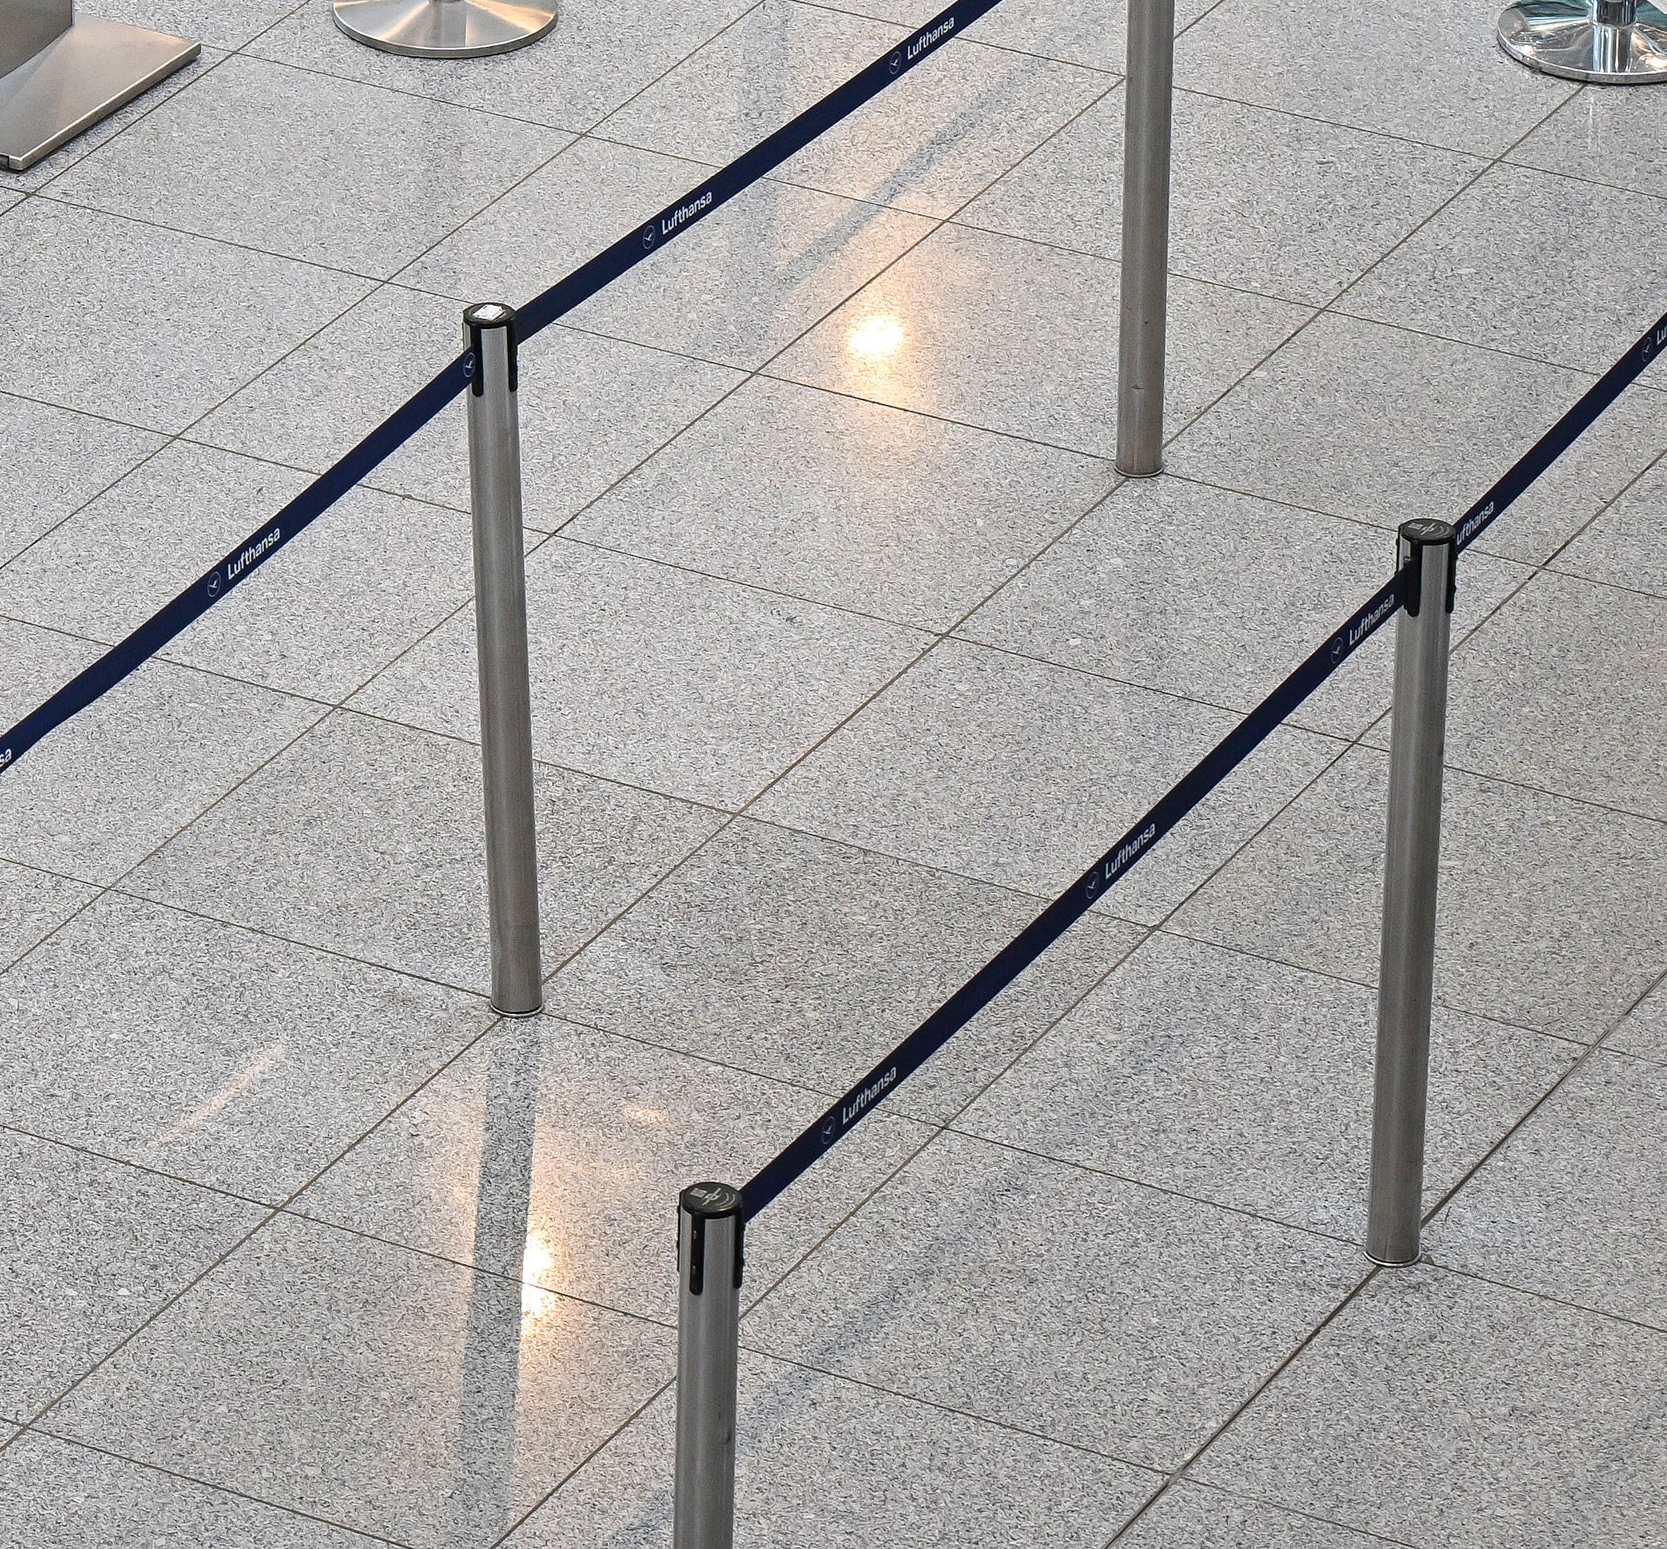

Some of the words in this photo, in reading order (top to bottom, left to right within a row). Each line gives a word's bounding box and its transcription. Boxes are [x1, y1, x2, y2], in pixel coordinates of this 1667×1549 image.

[907, 16, 955, 60] Lufthansa
[661, 191, 713, 235] Lufthansa
[1456, 501, 1495, 546] ufthansa
[227, 527, 281, 579] Lufthansa
[1349, 593, 1395, 646] Lufthansa
[1104, 822, 1156, 880] Lufthansa
[841, 1066, 897, 1125] Lufthansa
